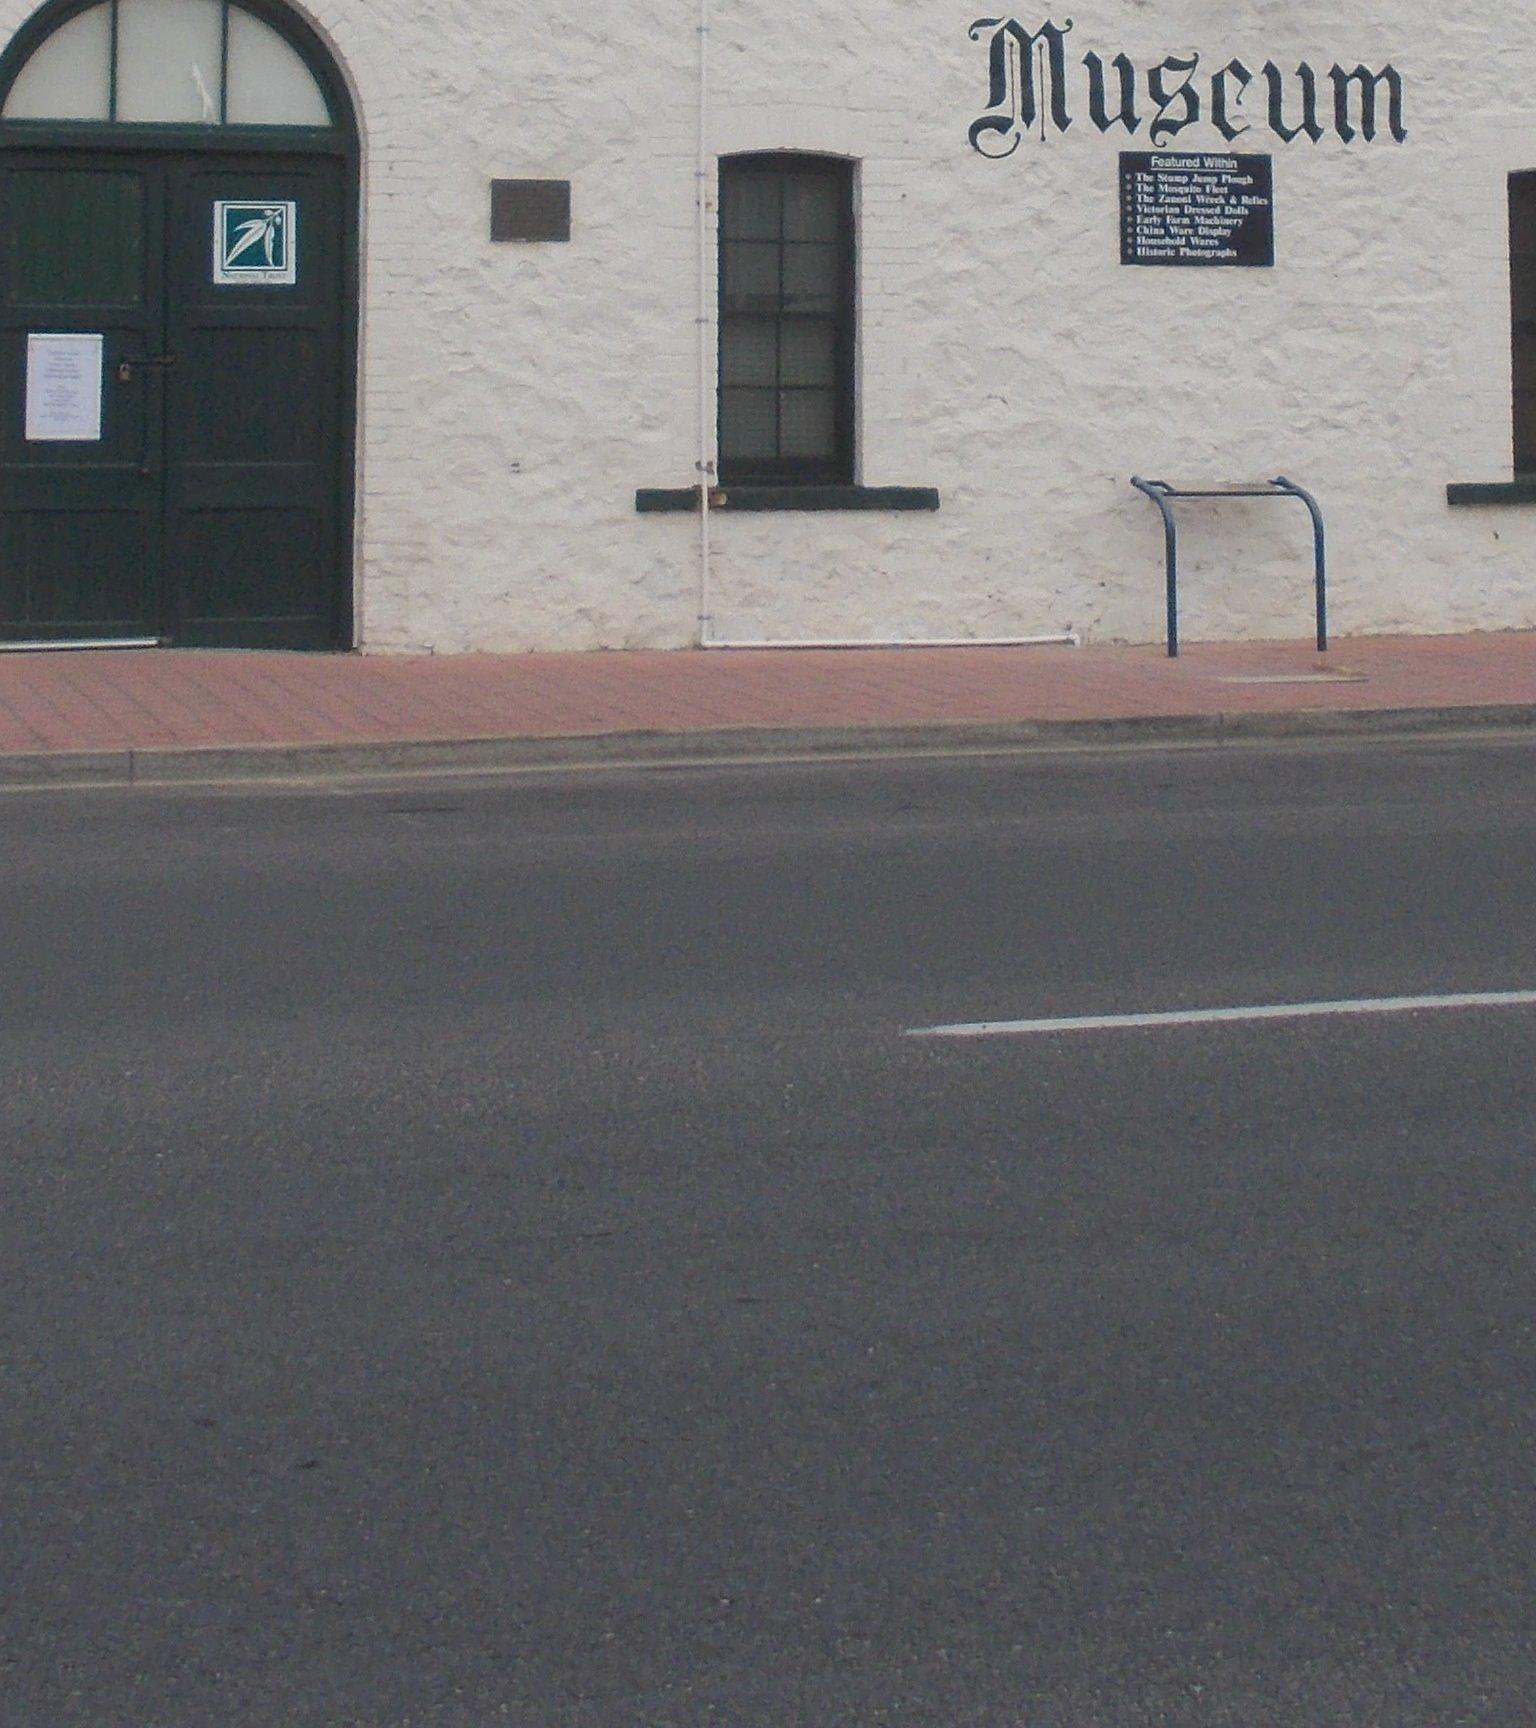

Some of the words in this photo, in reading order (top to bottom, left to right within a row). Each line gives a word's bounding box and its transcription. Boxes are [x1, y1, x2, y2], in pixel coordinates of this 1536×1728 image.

[968, 18, 1408, 159] Museum
[1151, 156, 1200, 168] Featured
[1203, 157, 1238, 169] Within
[1136, 174, 1153, 182] The
[1158, 174, 1188, 184] Stump
[1192, 174, 1217, 184] Jump
[1222, 174, 1253, 185] Plough
[1137, 184, 1154, 192] The
[1159, 184, 1201, 194] Mosquito
[1206, 185, 1228, 193] Fleet
[1137, 194, 1154, 203] The
[1195, 195, 1225, 204] Wreck
[1230, 196, 1237, 204] &
[1242, 196, 1268, 205] Relics
[1136, 205, 1180, 214] Victorian
[1184, 205, 1220, 214] Dressed
[1225, 205, 1249, 214] Dolls
[1136, 216, 1161, 225] Early
[1166, 216, 1190, 224] Farm
[1194, 216, 1243, 227] Machinery
[1136, 226, 1164, 234] China
[1169, 226, 1194, 235] Ware
[1198, 226, 1232, 237] Display
[1136, 237, 1186, 245] Household
[1190, 237, 1219, 246] Wares
[1136, 247, 1175, 256] Historic
[1179, 247, 1237, 258] Photographs
